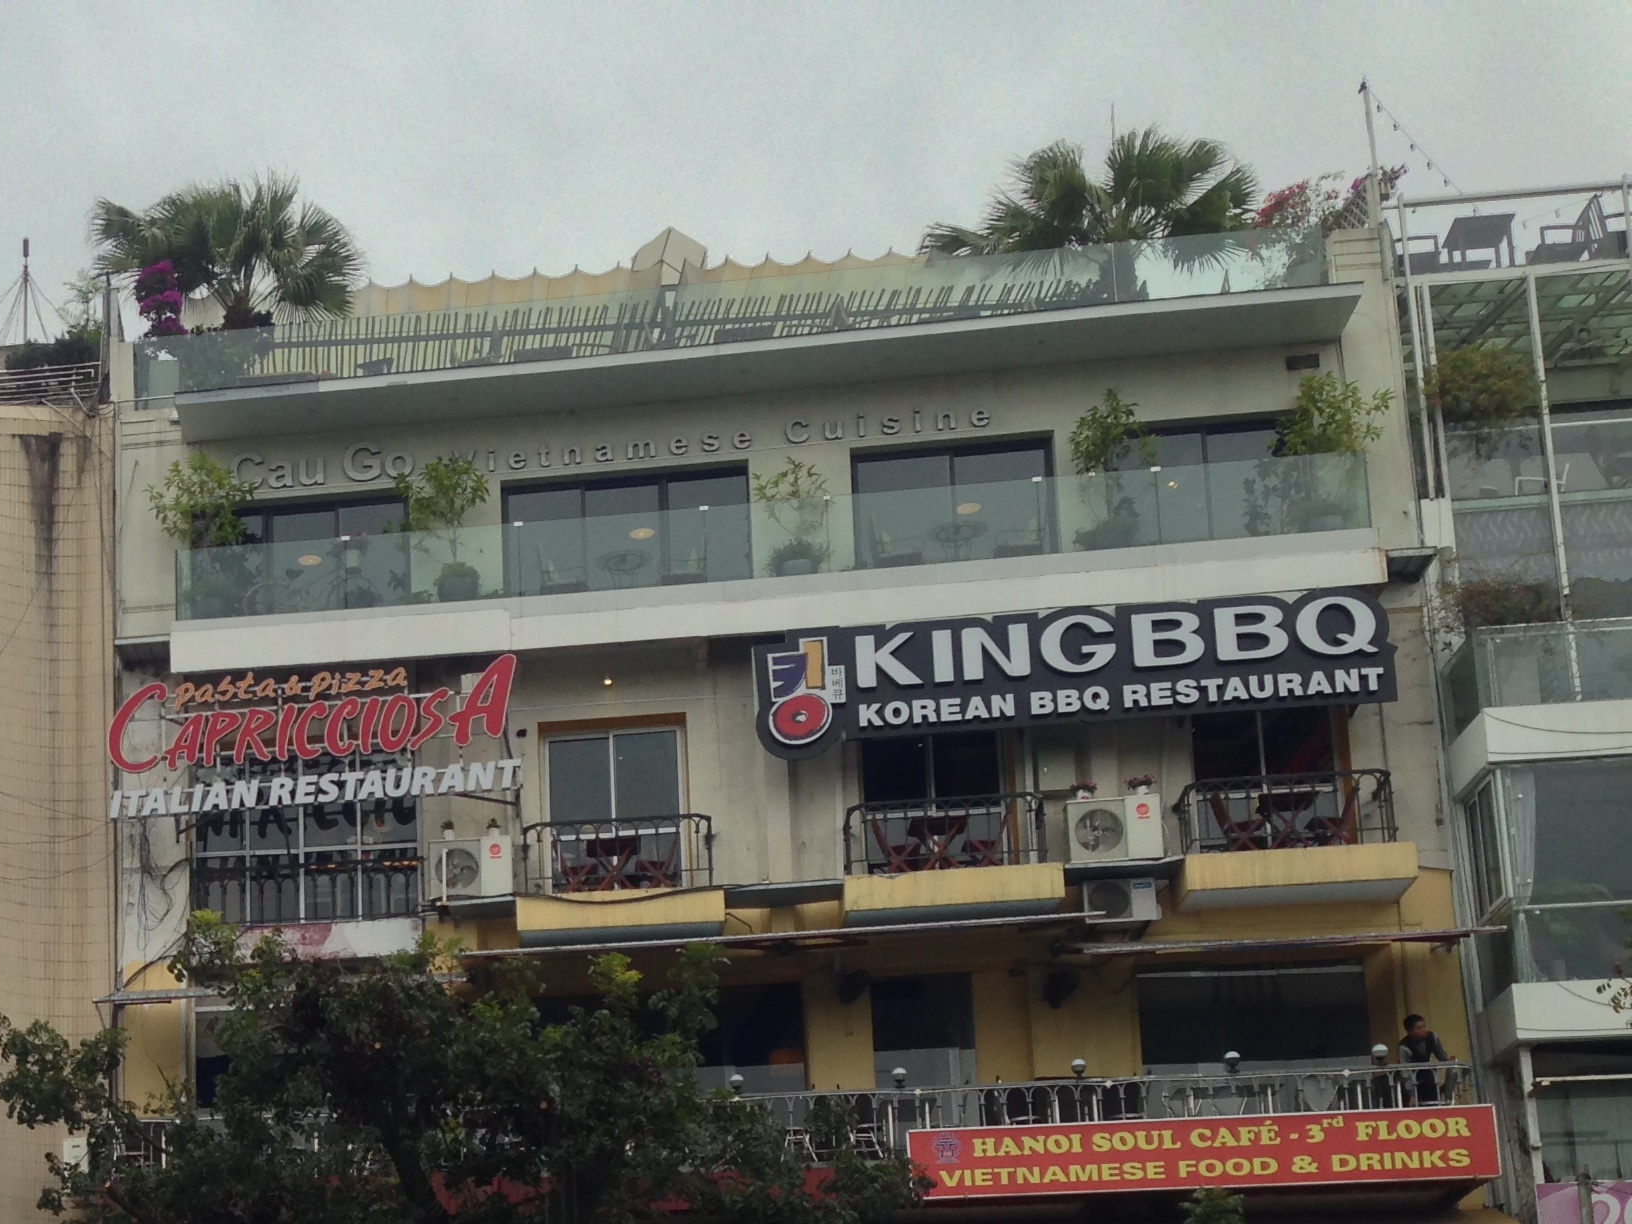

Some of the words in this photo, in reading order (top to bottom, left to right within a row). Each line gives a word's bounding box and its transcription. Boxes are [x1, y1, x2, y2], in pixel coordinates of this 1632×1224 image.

[230, 451, 327, 491] Cau
[343, 443, 414, 483] Go
[786, 404, 991, 444] Cuisine
[108, 653, 517, 774] CAPRICCIOSA
[286, 679, 301, 695] &
[859, 693, 1015, 727] KOREAN
[1031, 686, 1110, 717] BBQ
[1123, 667, 1384, 709] RESTAURANT
[110, 779, 259, 819] ITALIAN
[269, 759, 522, 807] RESTAURANT
[972, 1133, 1082, 1158] HANOI
[1092, 1130, 1181, 1152] SOUL
[1190, 1121, 1282, 1148] CAFÉ
[1306, 1115, 1344, 1142] 3rd
[1356, 1117, 1470, 1142] FLOOR
[938, 1160, 1165, 1187] VIETNAMESE
[1178, 1156, 1279, 1176] FOOD
[1291, 1154, 1319, 1173] &
[1331, 1148, 1471, 1172] DRINKS
